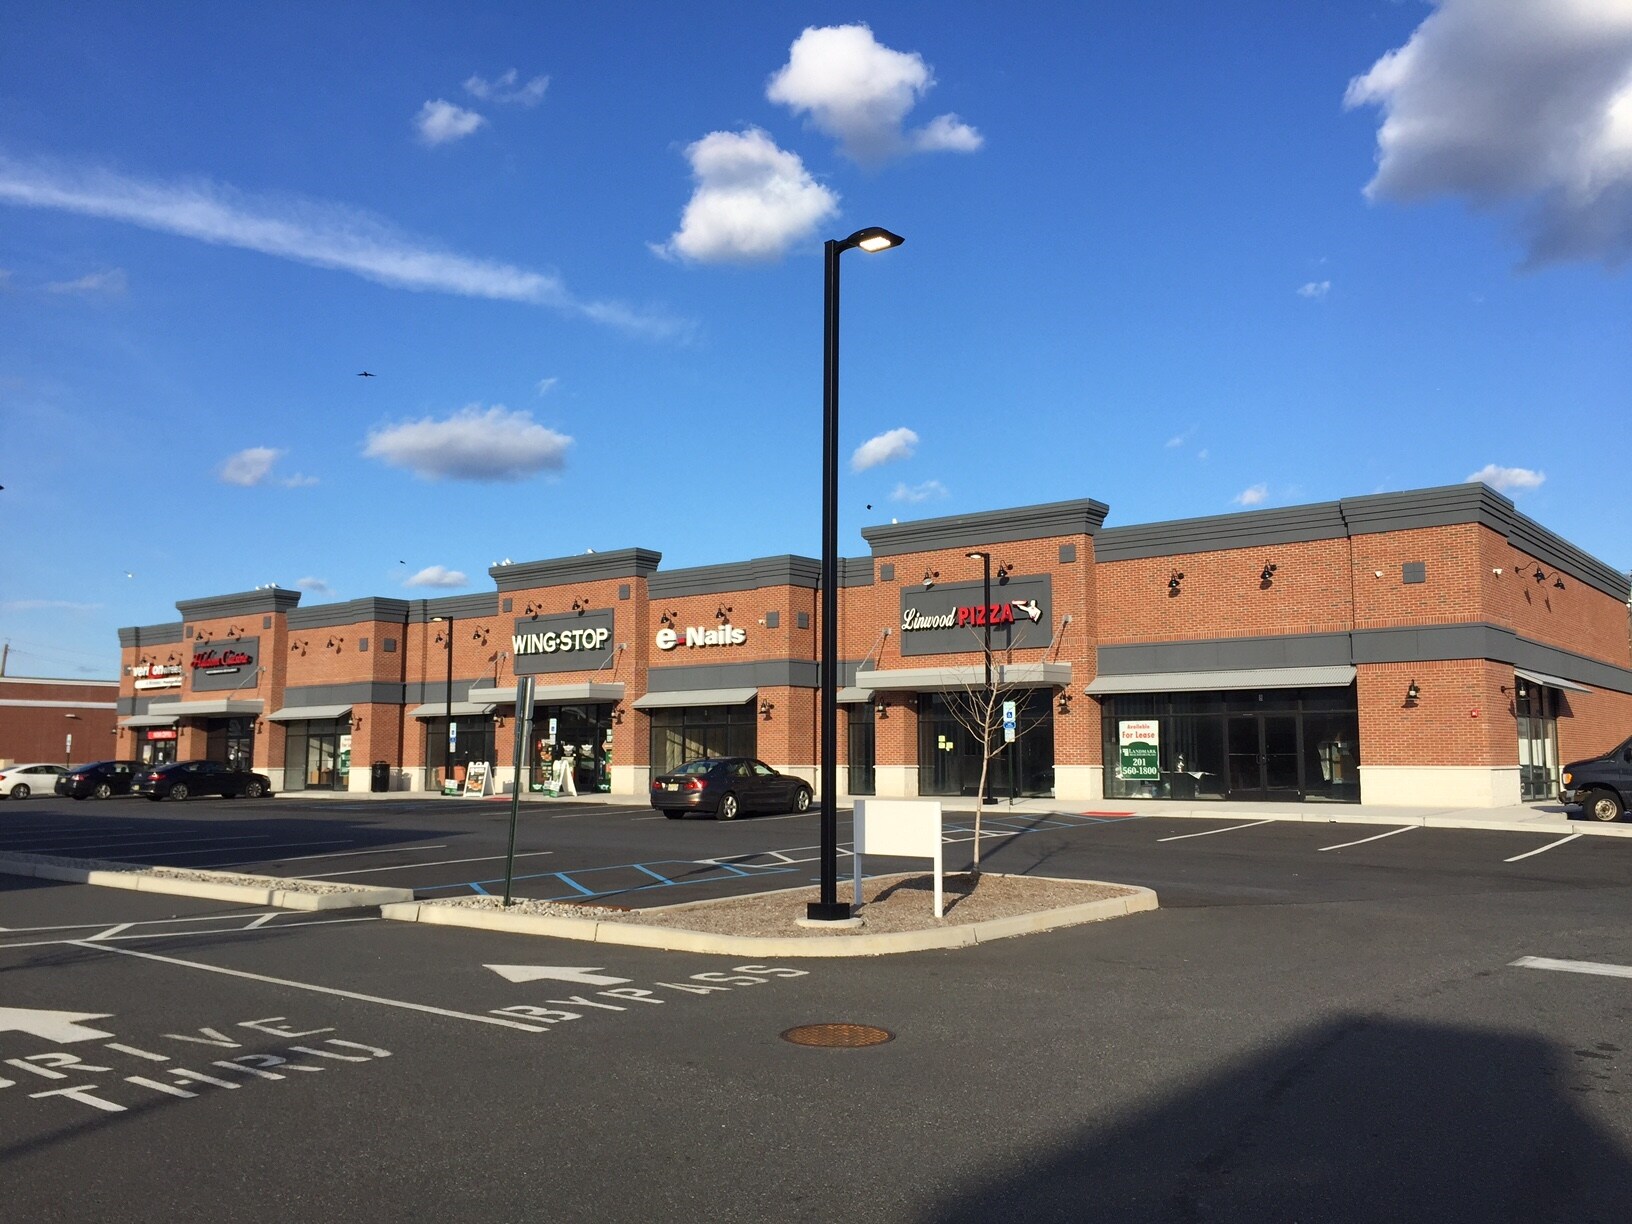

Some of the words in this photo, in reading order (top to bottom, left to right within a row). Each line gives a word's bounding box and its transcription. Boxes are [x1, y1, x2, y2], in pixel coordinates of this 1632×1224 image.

[902, 607, 956, 630] Linwood
[958, 603, 1014, 626] PIZZA
[656, 624, 747, 650] e-Nails
[1122, 731, 1133, 739] For
[1135, 731, 1155, 739] Lease
[1122, 767, 1157, 775] 560-1800
[1132, 758, 1146, 766] 201
[488, 965, 810, 1023] BYPASS
[0, 1017, 335, 1089] RIVE
[28, 1038, 392, 1112] THRU
